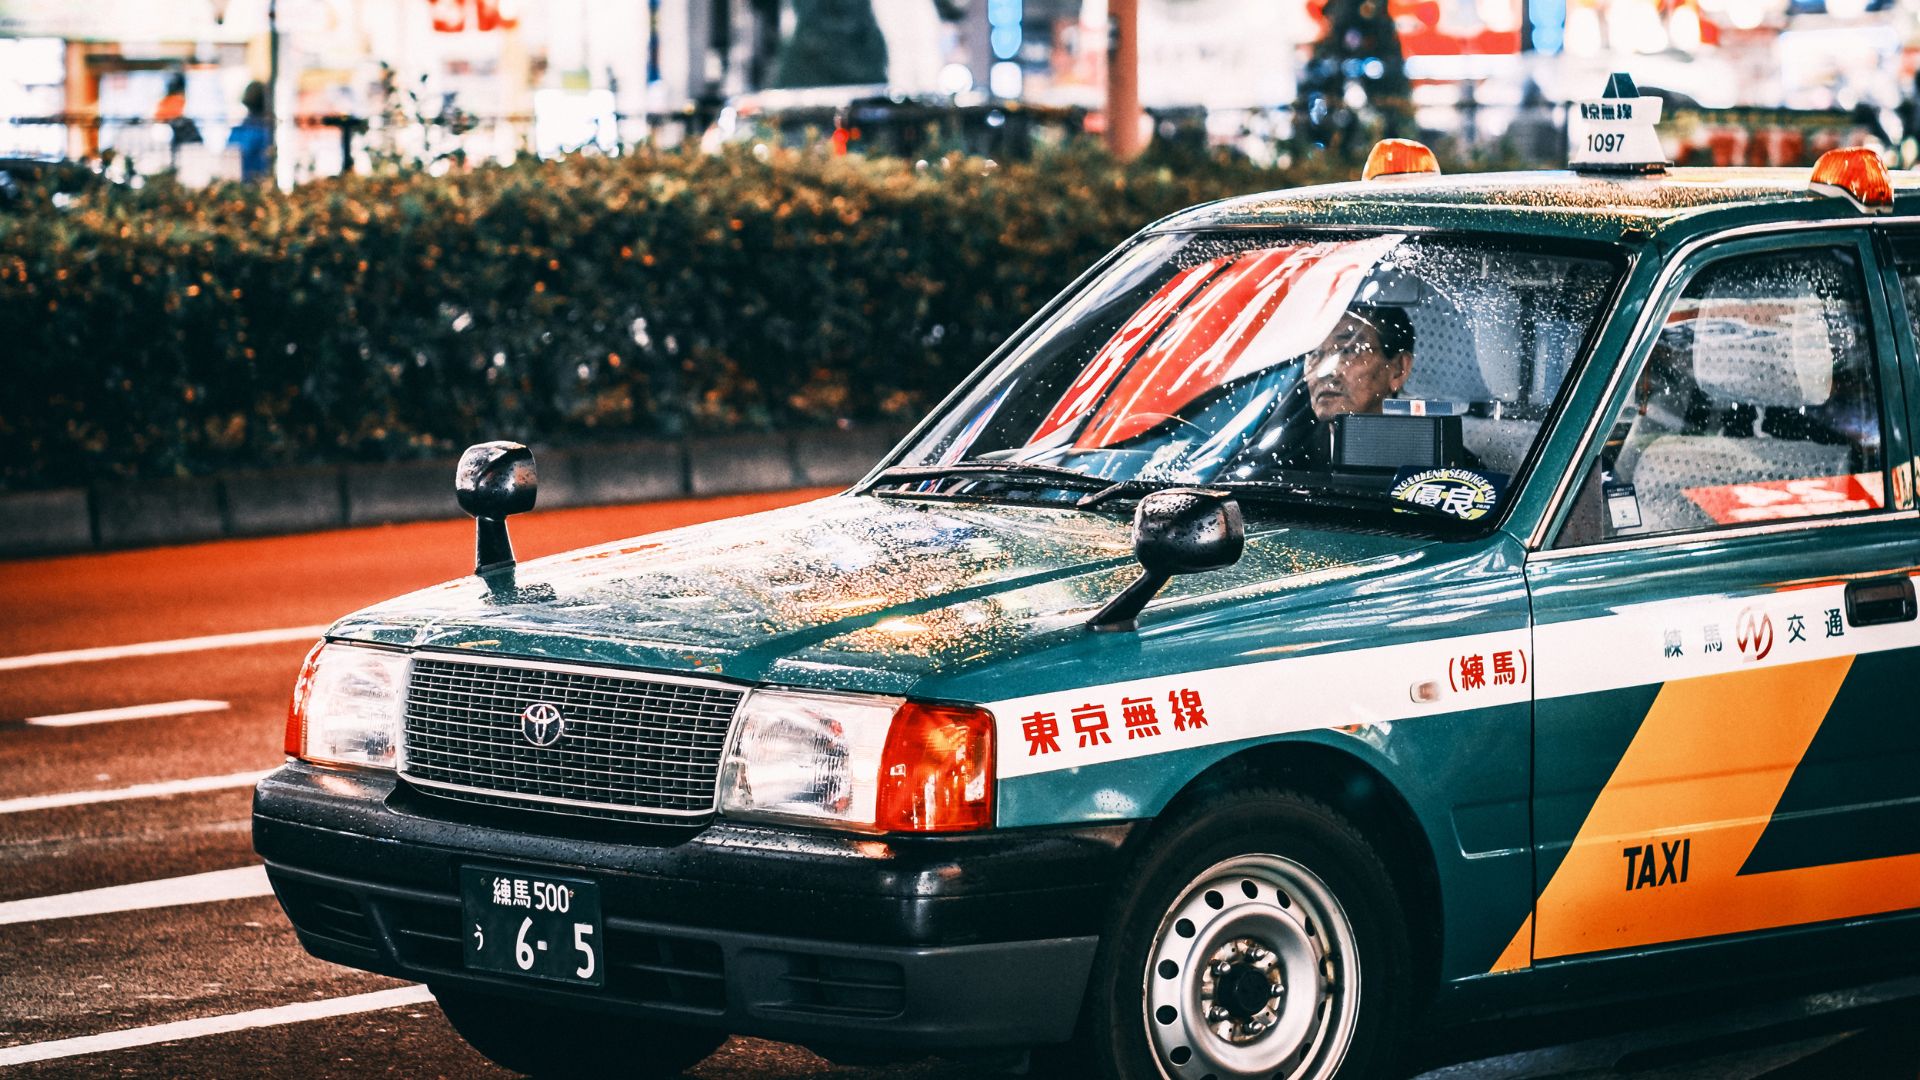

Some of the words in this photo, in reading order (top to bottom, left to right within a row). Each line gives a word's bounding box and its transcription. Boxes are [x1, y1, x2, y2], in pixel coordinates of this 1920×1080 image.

[1587, 133, 1625, 153] 1097
[1449, 468, 1488, 488] SERVICE
[1404, 482, 1478, 519] 優良
[1786, 607, 1845, 644] 交通
[1020, 688, 1208, 757] 東京無線
[1623, 838, 1691, 891] TAXI
[492, 876, 531, 909] 練馬
[533, 881, 570, 914] 500
[473, 923, 484, 951] う
